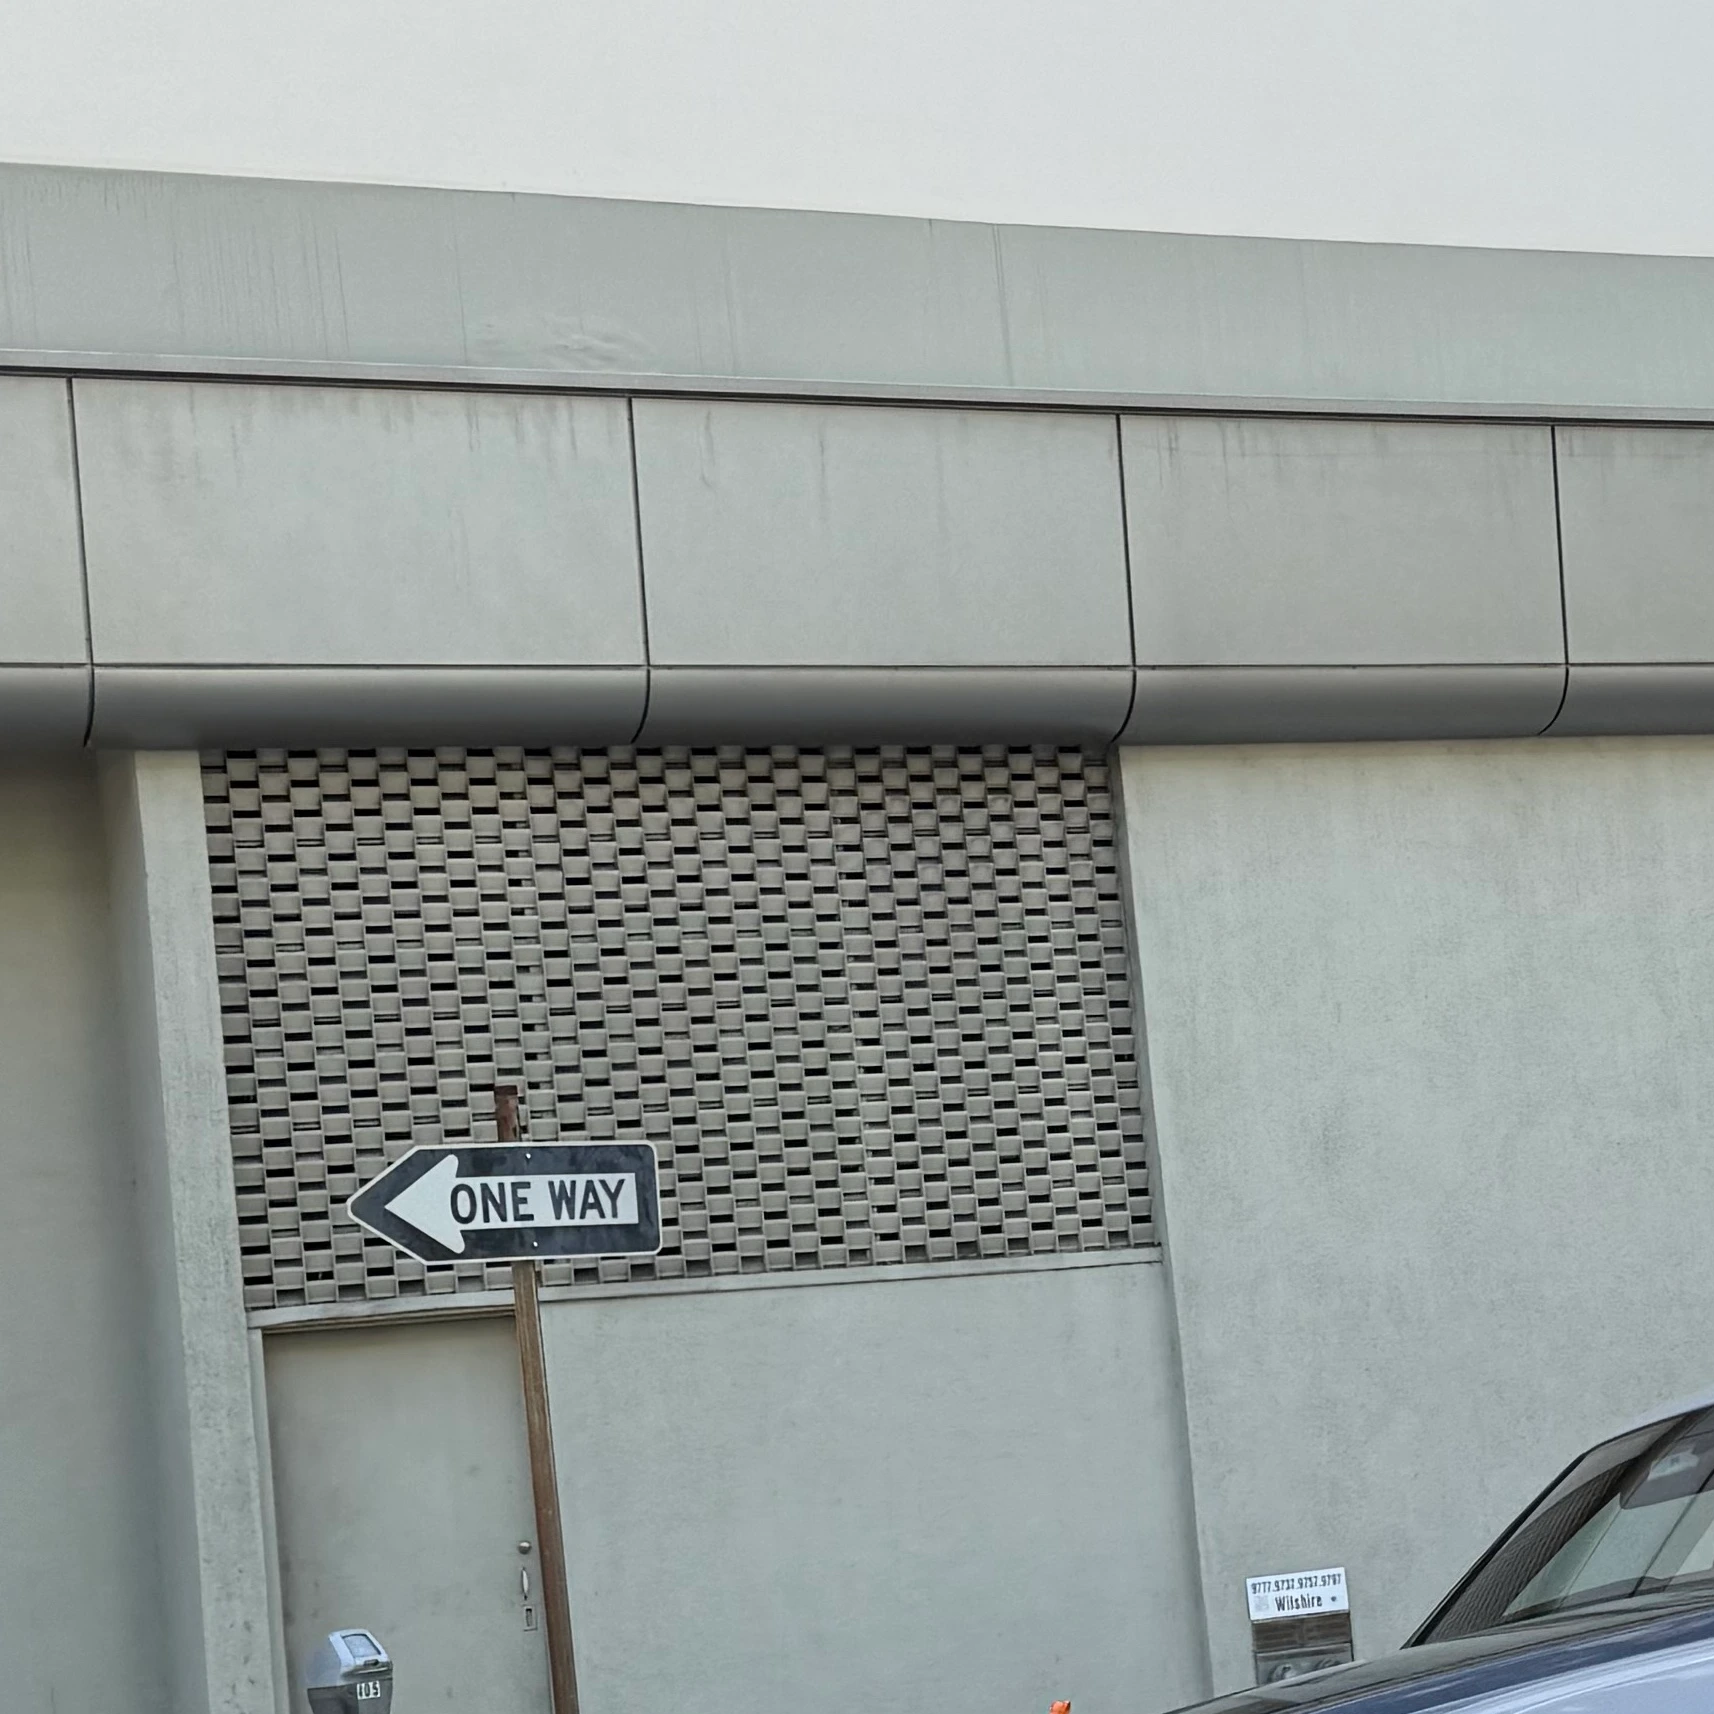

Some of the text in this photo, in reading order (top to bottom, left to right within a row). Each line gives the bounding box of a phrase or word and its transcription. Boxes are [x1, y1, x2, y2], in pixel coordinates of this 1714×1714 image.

[450, 1178, 626, 1225] ONE WAY
[1275, 1593, 1323, 1611] Wilshire
